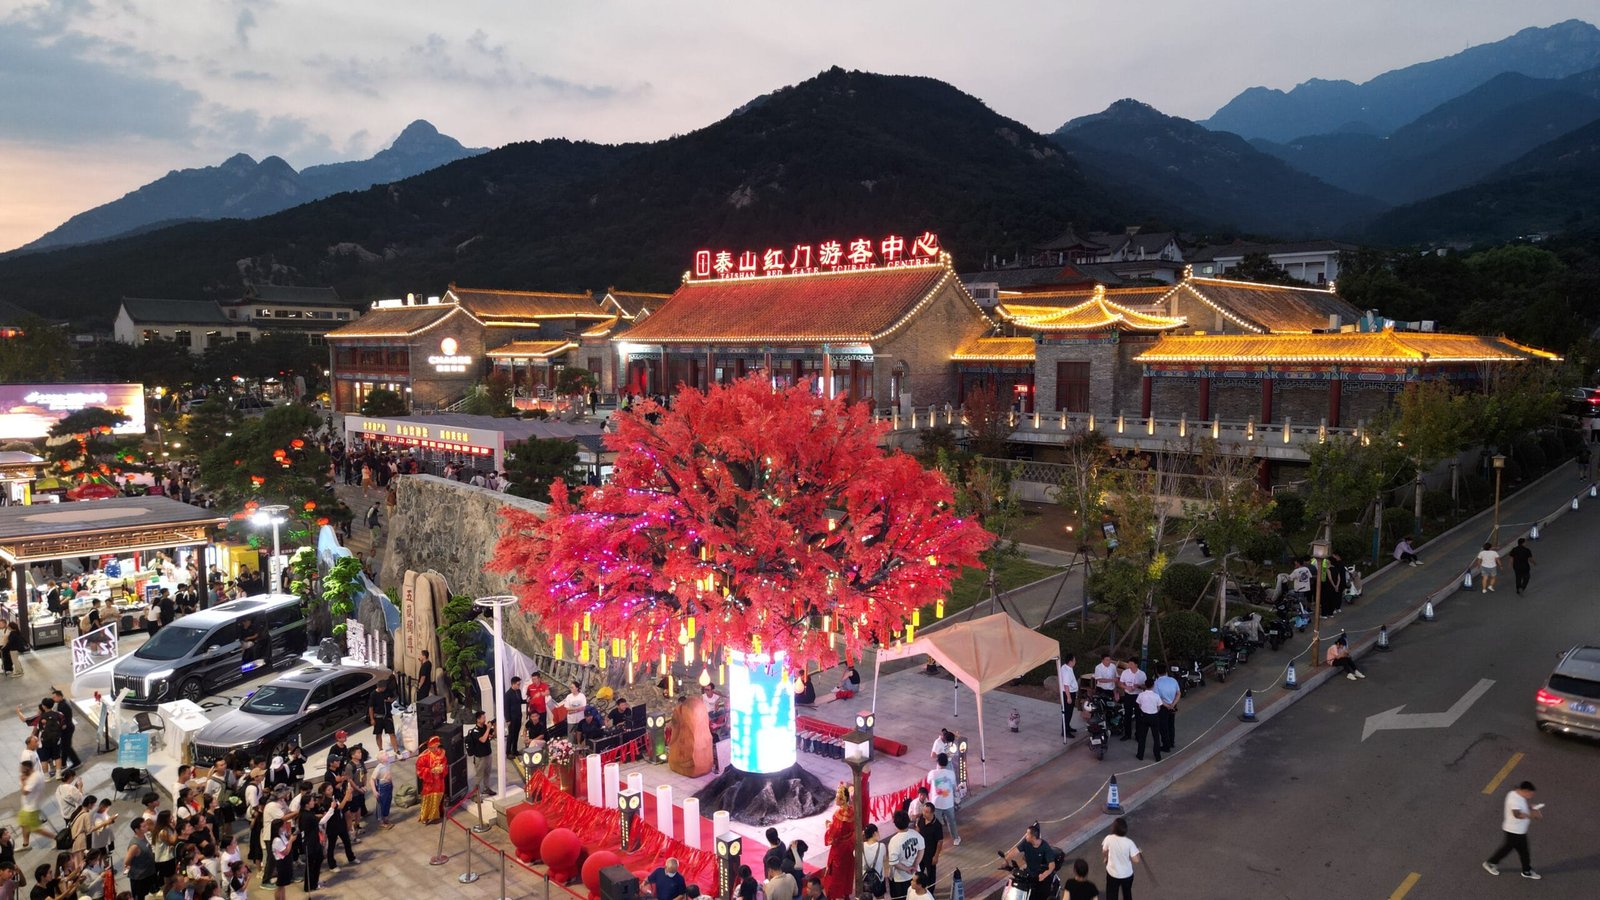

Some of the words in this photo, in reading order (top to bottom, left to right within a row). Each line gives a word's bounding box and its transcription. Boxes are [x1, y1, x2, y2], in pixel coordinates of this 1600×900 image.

[713, 231, 939, 273] 泰山红门游客中心
[720, 271, 756, 280] TAISHAN
[766, 269, 783, 277] RED
[791, 267, 819, 275] GATE
[831, 263, 876, 273] TOURIST
[887, 258, 930, 269] CENTRE
